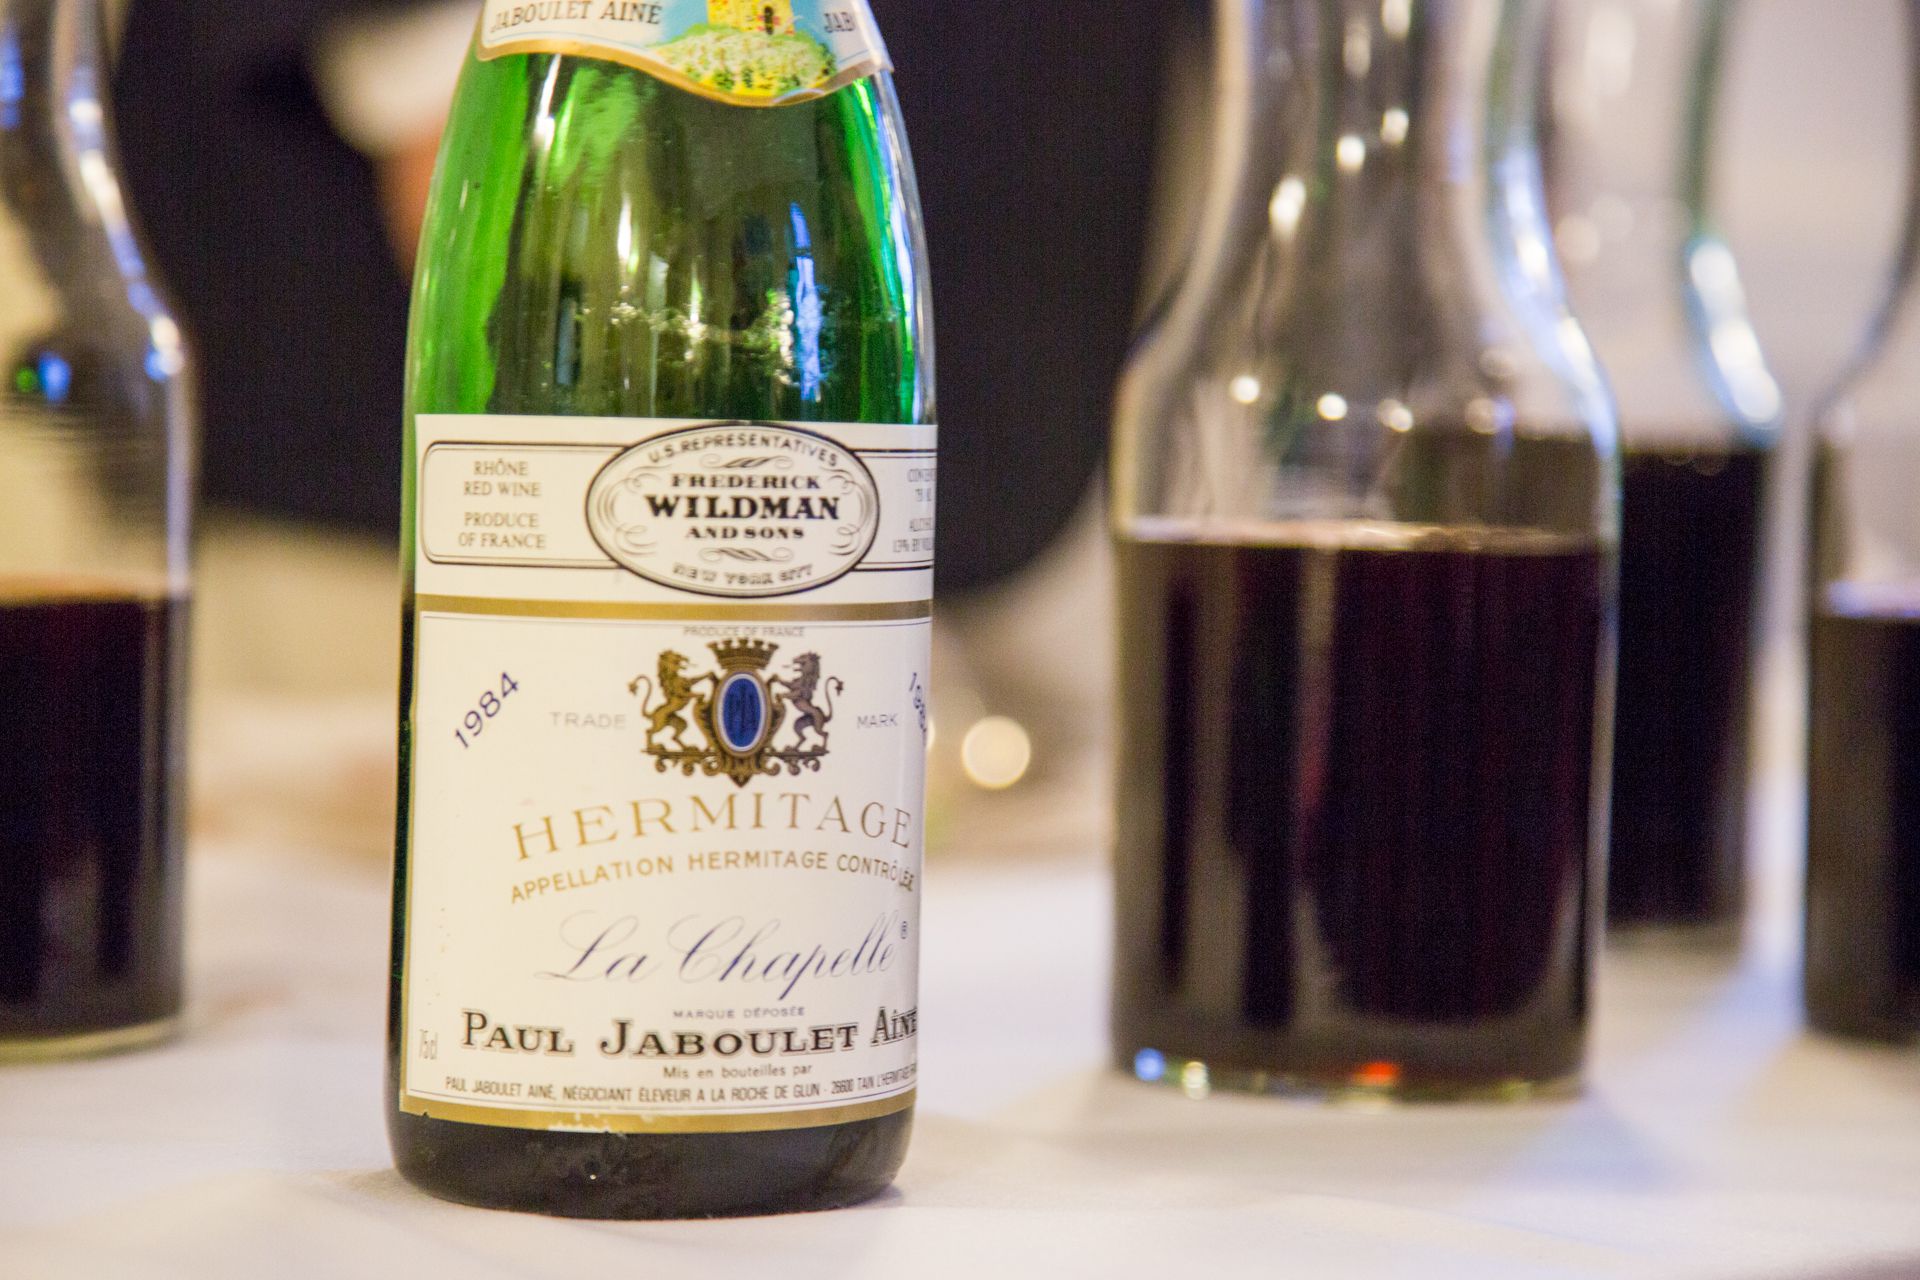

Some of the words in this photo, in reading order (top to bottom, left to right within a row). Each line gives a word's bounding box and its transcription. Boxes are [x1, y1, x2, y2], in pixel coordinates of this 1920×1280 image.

[490, 0, 592, 33] JABOULET
[680, 432, 839, 467] REPRESENTATIVES
[474, 458, 528, 476] RHÔNE
[463, 481, 492, 496] RED
[497, 482, 541, 497] WINE
[671, 473, 821, 489] FREDERICK
[645, 495, 841, 520] WILDMAN
[464, 511, 539, 528] PRODUCE
[458, 531, 476, 547] OF
[480, 533, 547, 549] FRANCE
[686, 526, 739, 540] AND
[743, 526, 806, 540] SONS
[455, 672, 519, 749] 1984
[550, 711, 627, 730] TRADE
[857, 713, 899, 729] MARK
[512, 792, 912, 861] HERMITAGE
[511, 854, 673, 904] APPELLATION
[688, 849, 829, 871] HERMITAGE
[533, 909, 656, 984] La
[666, 907, 899, 1001] Chapelle
[673, 1008, 736, 1020] MARQUE
[743, 1005, 806, 1019] DÉPOSÉE
[461, 1009, 575, 1056] PAUL
[599, 1019, 859, 1060] JABOULET
[663, 1066, 690, 1080] Mis
[697, 1068, 714, 1079] en
[721, 1063, 787, 1079] bouteilles
[792, 1064, 813, 1076] par
[446, 1076, 466, 1092] PAUL
[472, 1079, 523, 1096] JABOULET
[711, 1087, 726, 1101] LA
[731, 1086, 769, 1101] ROCHE
[774, 1085, 788, 1099] DE
